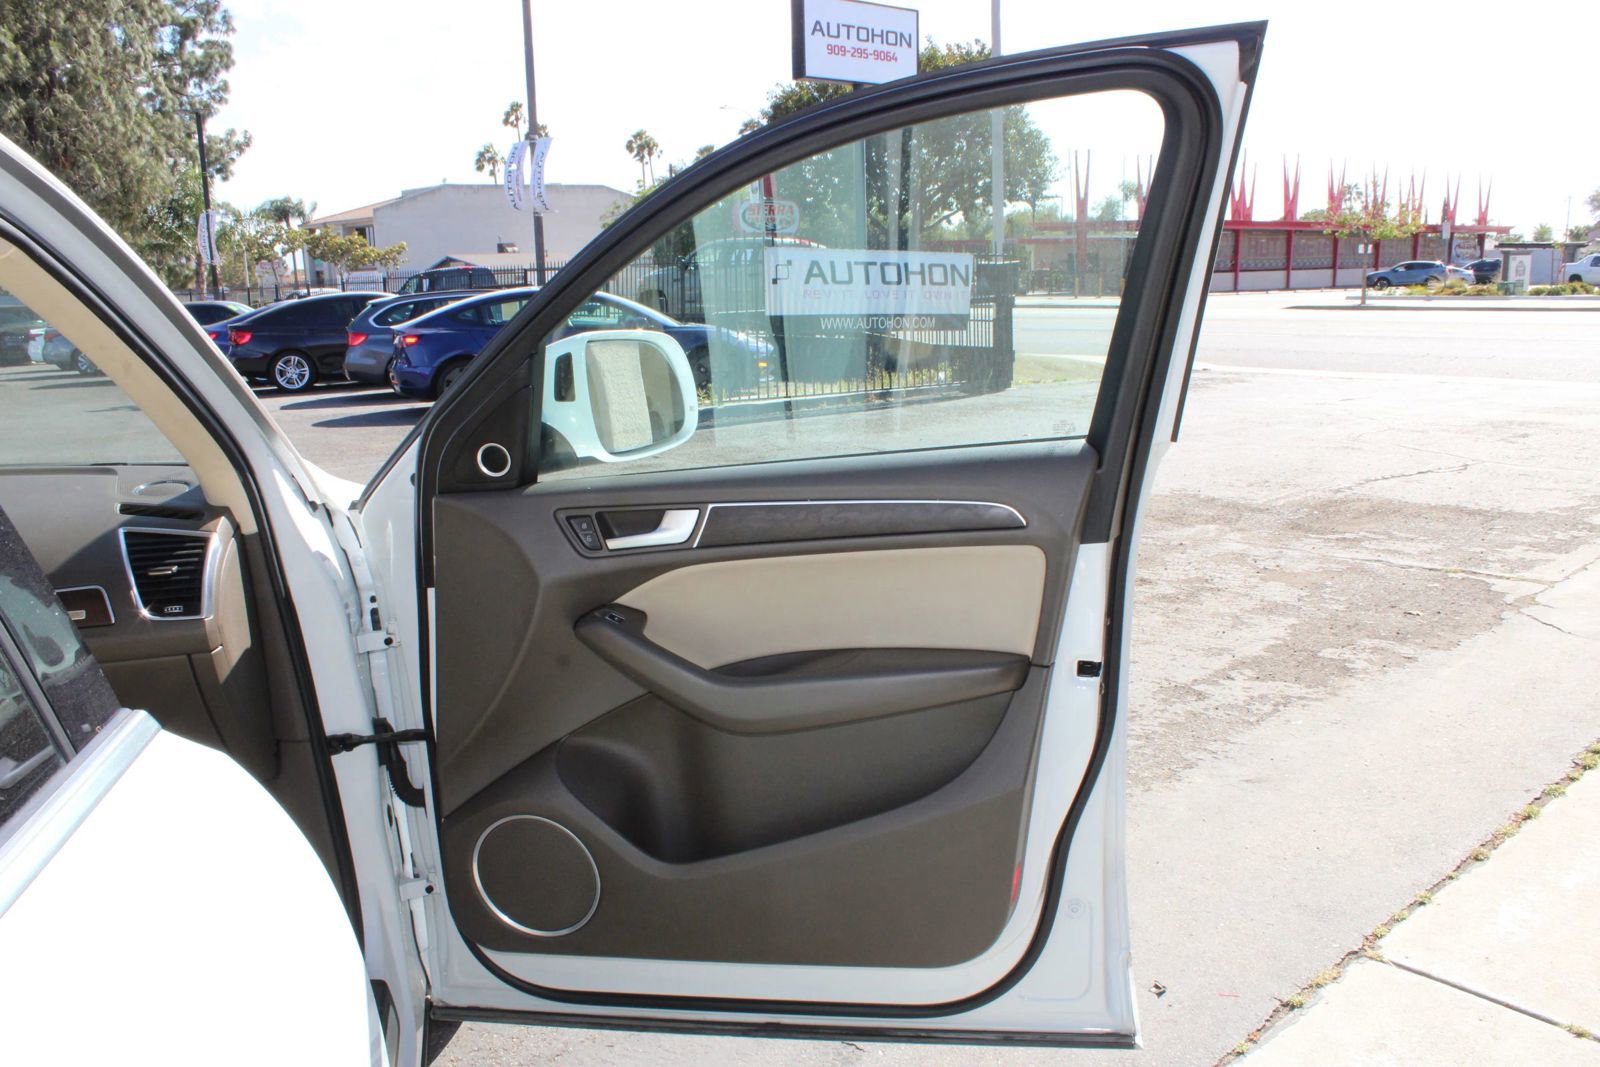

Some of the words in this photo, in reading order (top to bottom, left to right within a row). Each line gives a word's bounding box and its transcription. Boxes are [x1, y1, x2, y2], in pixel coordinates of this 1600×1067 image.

[811, 20, 912, 48] AUTOHON
[826, 44, 898, 62] 909-295-9064
[804, 260, 970, 286] AUTOHON
[820, 316, 936, 330] WWW.AUTOHON.COM
